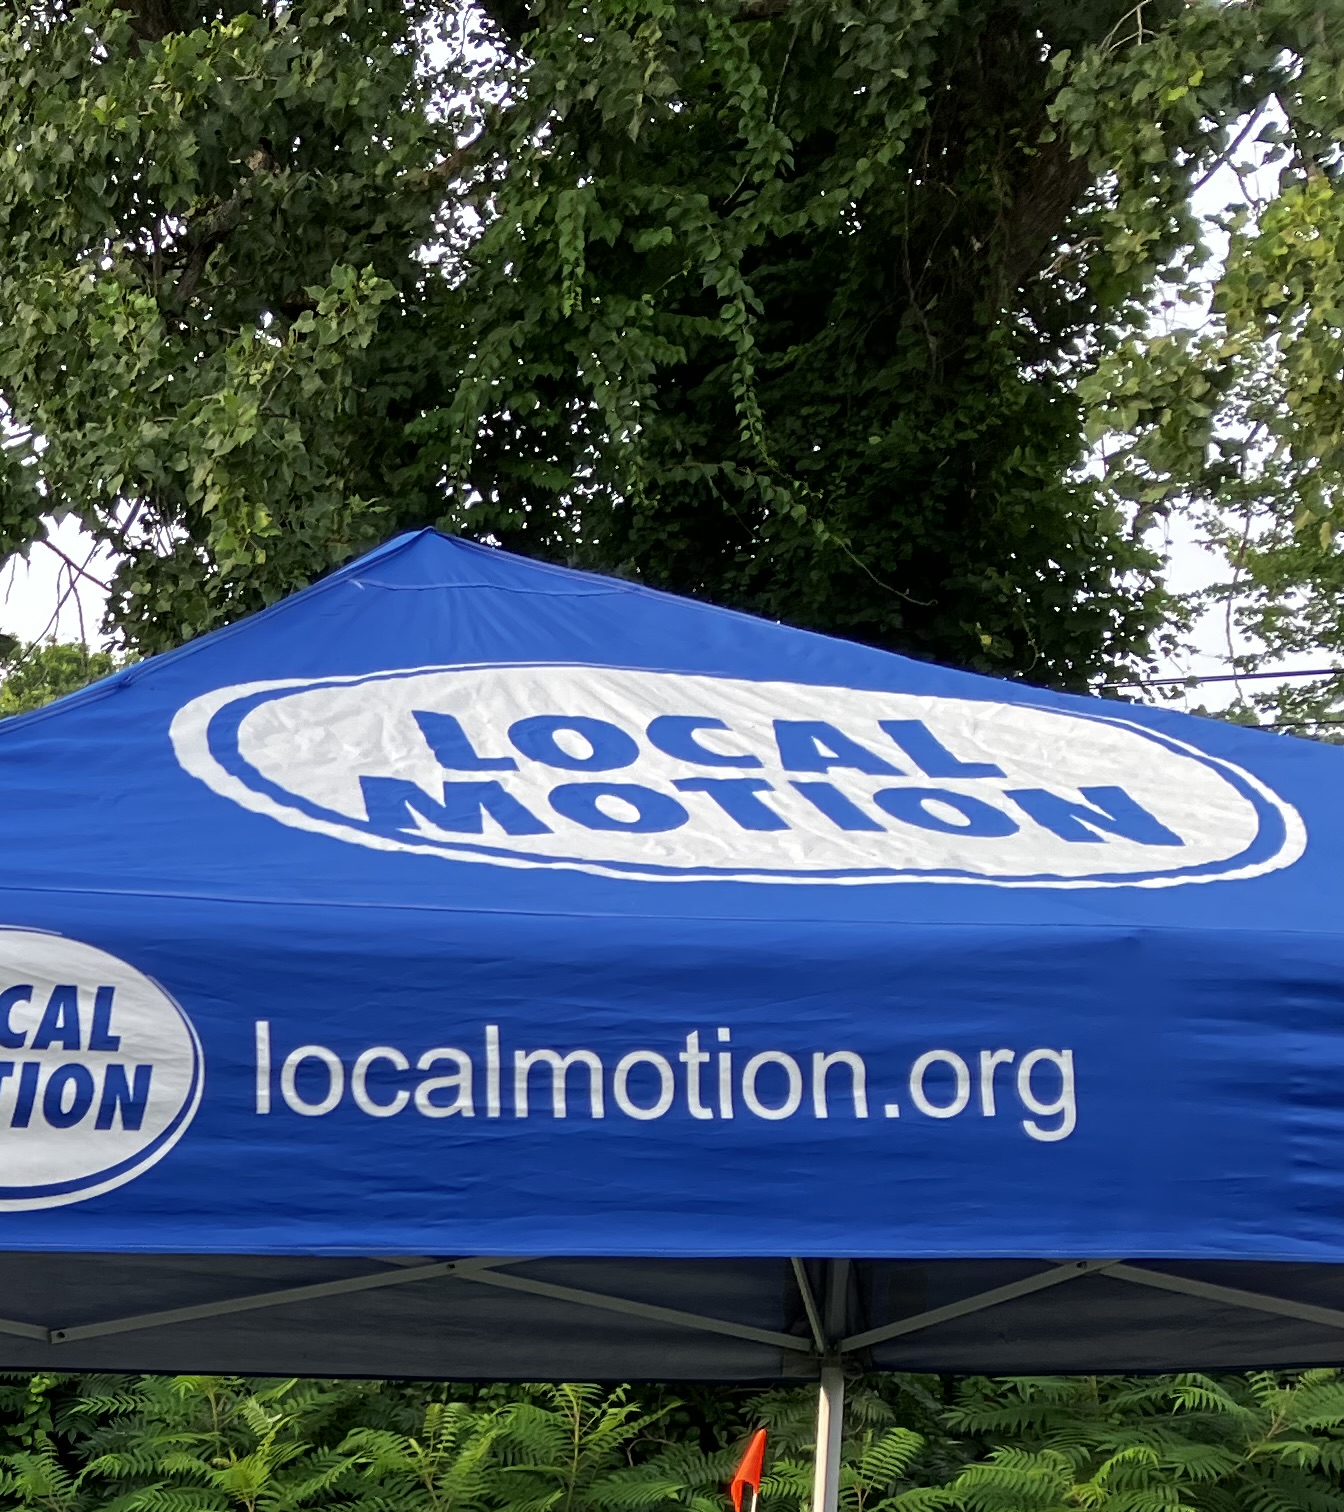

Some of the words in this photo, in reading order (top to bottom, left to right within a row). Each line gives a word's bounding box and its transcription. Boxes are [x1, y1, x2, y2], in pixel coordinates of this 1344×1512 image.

[413, 709, 1009, 780] LOCAL
[357, 774, 1186, 848] MOTION
[254, 1020, 1078, 1143] localmotion.org
